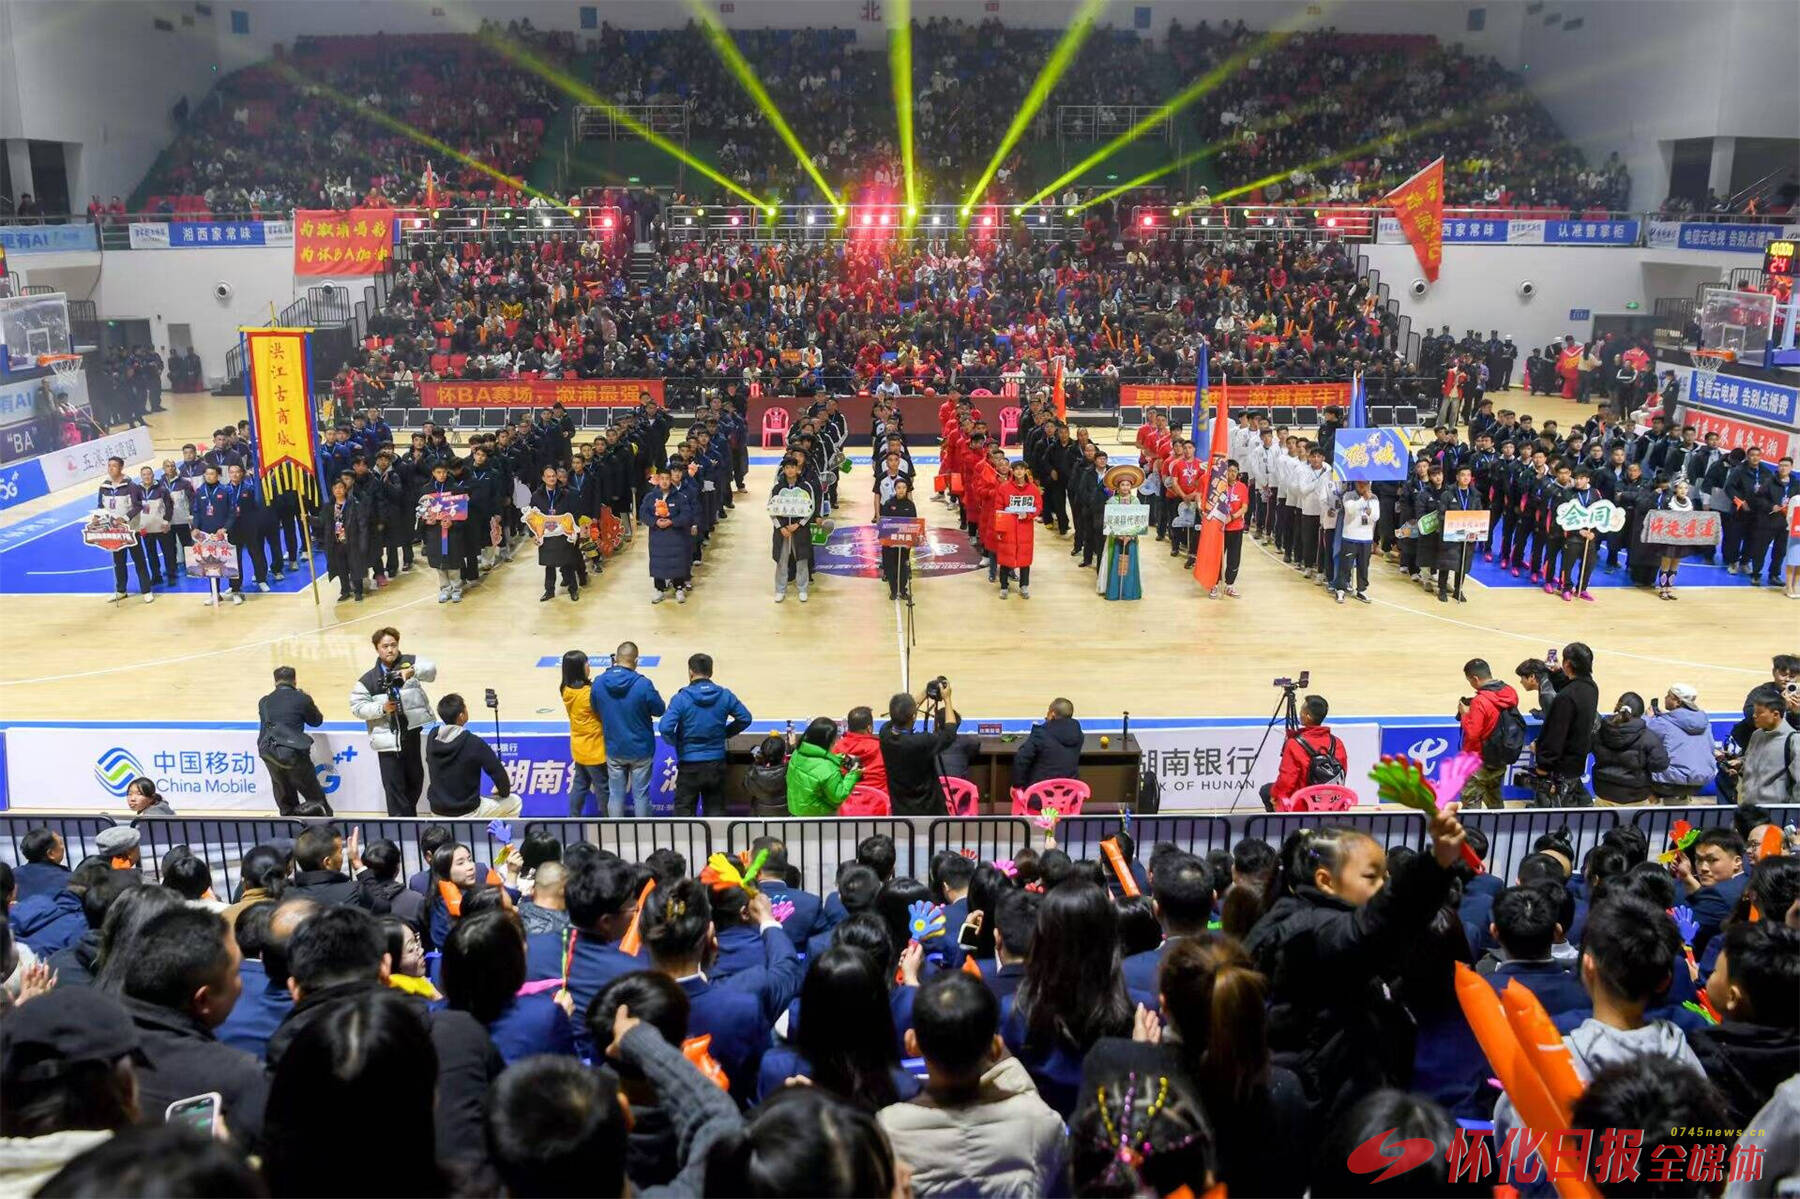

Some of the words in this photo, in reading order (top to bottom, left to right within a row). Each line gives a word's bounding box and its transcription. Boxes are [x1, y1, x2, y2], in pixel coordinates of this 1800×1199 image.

[183, 226, 251, 241] 湘西家常味
[1769, 258, 1787, 272] 24
[270, 342, 296, 446] 洪江古商城
[1560, 502, 1612, 527] 会同
[153, 750, 255, 775] 中国移动
[156, 778, 201, 793] China
[205, 778, 257, 794] Mobile
[1174, 781, 1195, 791] OF
[1201, 780, 1255, 790] HUNAN
